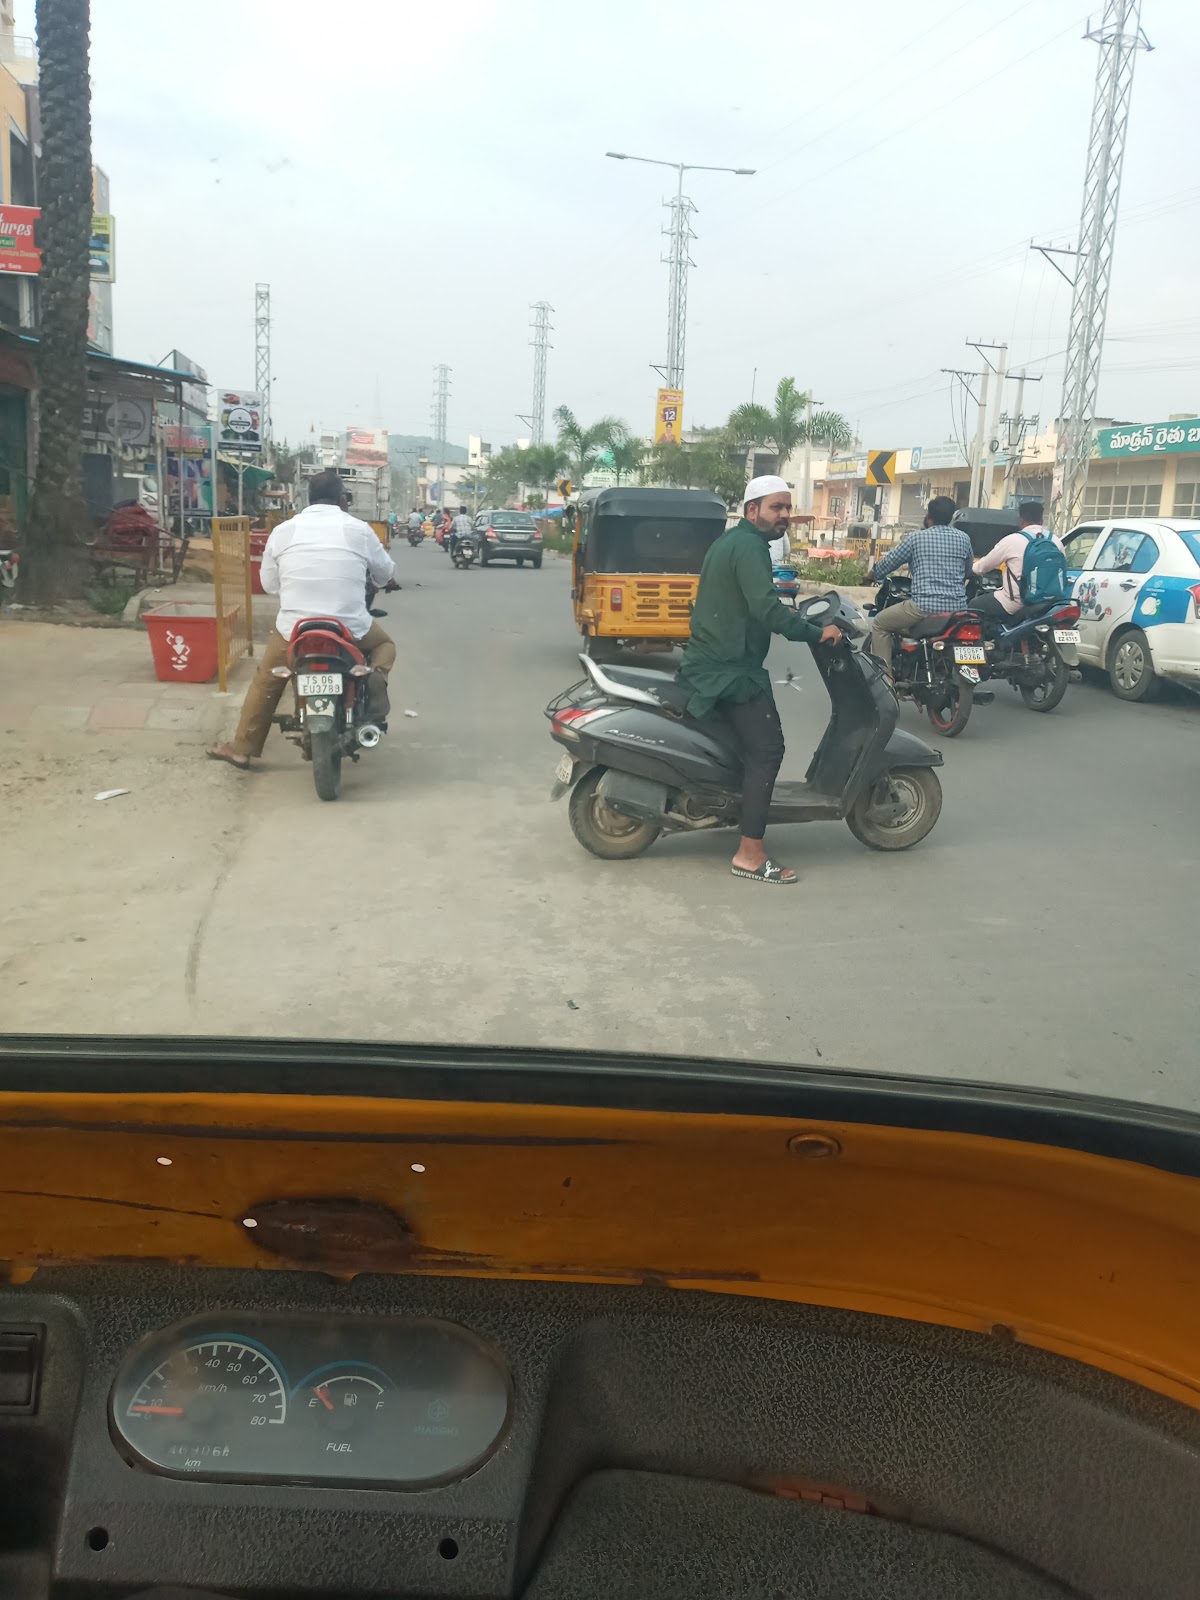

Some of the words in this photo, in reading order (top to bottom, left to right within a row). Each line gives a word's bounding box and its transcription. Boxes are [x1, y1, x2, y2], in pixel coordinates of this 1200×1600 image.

[664, 410, 676, 421] 12
[1154, 425, 1185, 451] రైతు
[306, 675, 317, 684] TS
[321, 675, 333, 684] 06
[303, 685, 340, 694] EU3789
[204, 1359, 221, 1368] 40
[226, 1363, 242, 1372] 50
[242, 1375, 258, 1384] 60
[198, 1383, 227, 1393] km/h
[251, 1394, 266, 1403] 70
[308, 1398, 318, 1407] E
[375, 1401, 384, 1410] F
[250, 1416, 266, 1425] 80
[326, 1442, 352, 1452] FUEL
[184, 1459, 201, 1467] km
